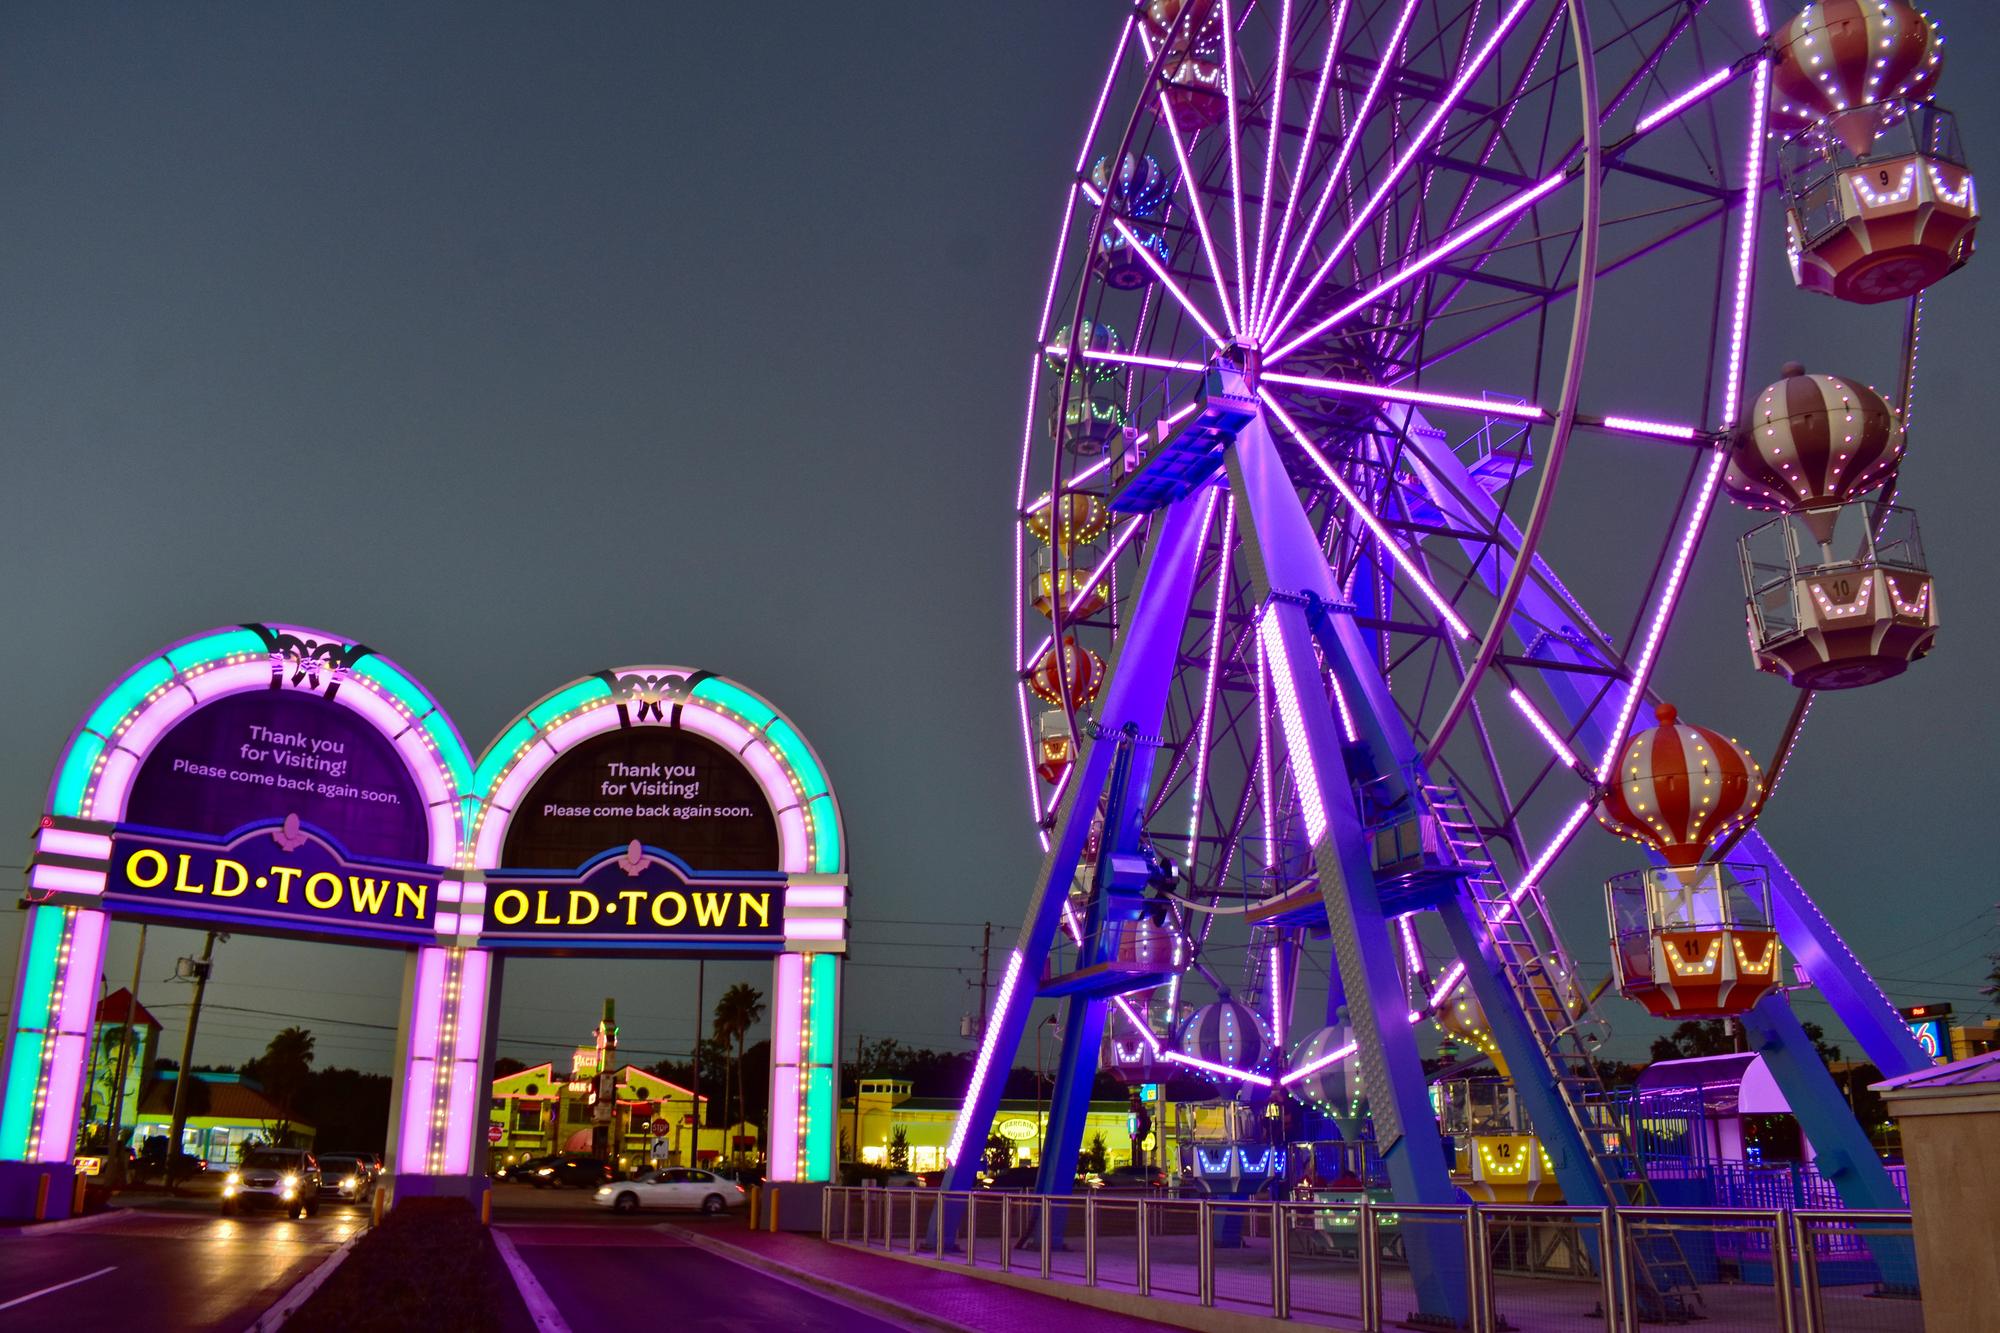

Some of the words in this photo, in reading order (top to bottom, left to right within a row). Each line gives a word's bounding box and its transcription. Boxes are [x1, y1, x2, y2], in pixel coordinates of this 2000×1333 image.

[1880, 170, 1888, 186] 9
[1832, 579, 1849, 597] 10
[249, 725, 307, 749] Thank
[310, 737, 345, 754] you
[240, 744, 269, 761] for
[273, 749, 347, 777] Visiting!
[607, 762, 660, 778] Thank
[664, 764, 696, 780] you
[173, 758, 228, 779] Please
[229, 770, 275, 786] come
[277, 775, 315, 792] back
[317, 783, 359, 798] again
[360, 789, 401, 805] soon.
[600, 781, 627, 796] for
[630, 781, 700, 799] Visiting!
[543, 804, 591, 817] Please
[593, 806, 634, 817] come
[635, 804, 671, 817] back
[672, 804, 712, 820] again
[713, 806, 754, 817] soon.
[1684, 939, 1699, 956] 11
[653, 1124, 669, 1132] STOP
[1004, 1120, 1035, 1130] BARGAIN
[1497, 1143, 1510, 1158] 12
